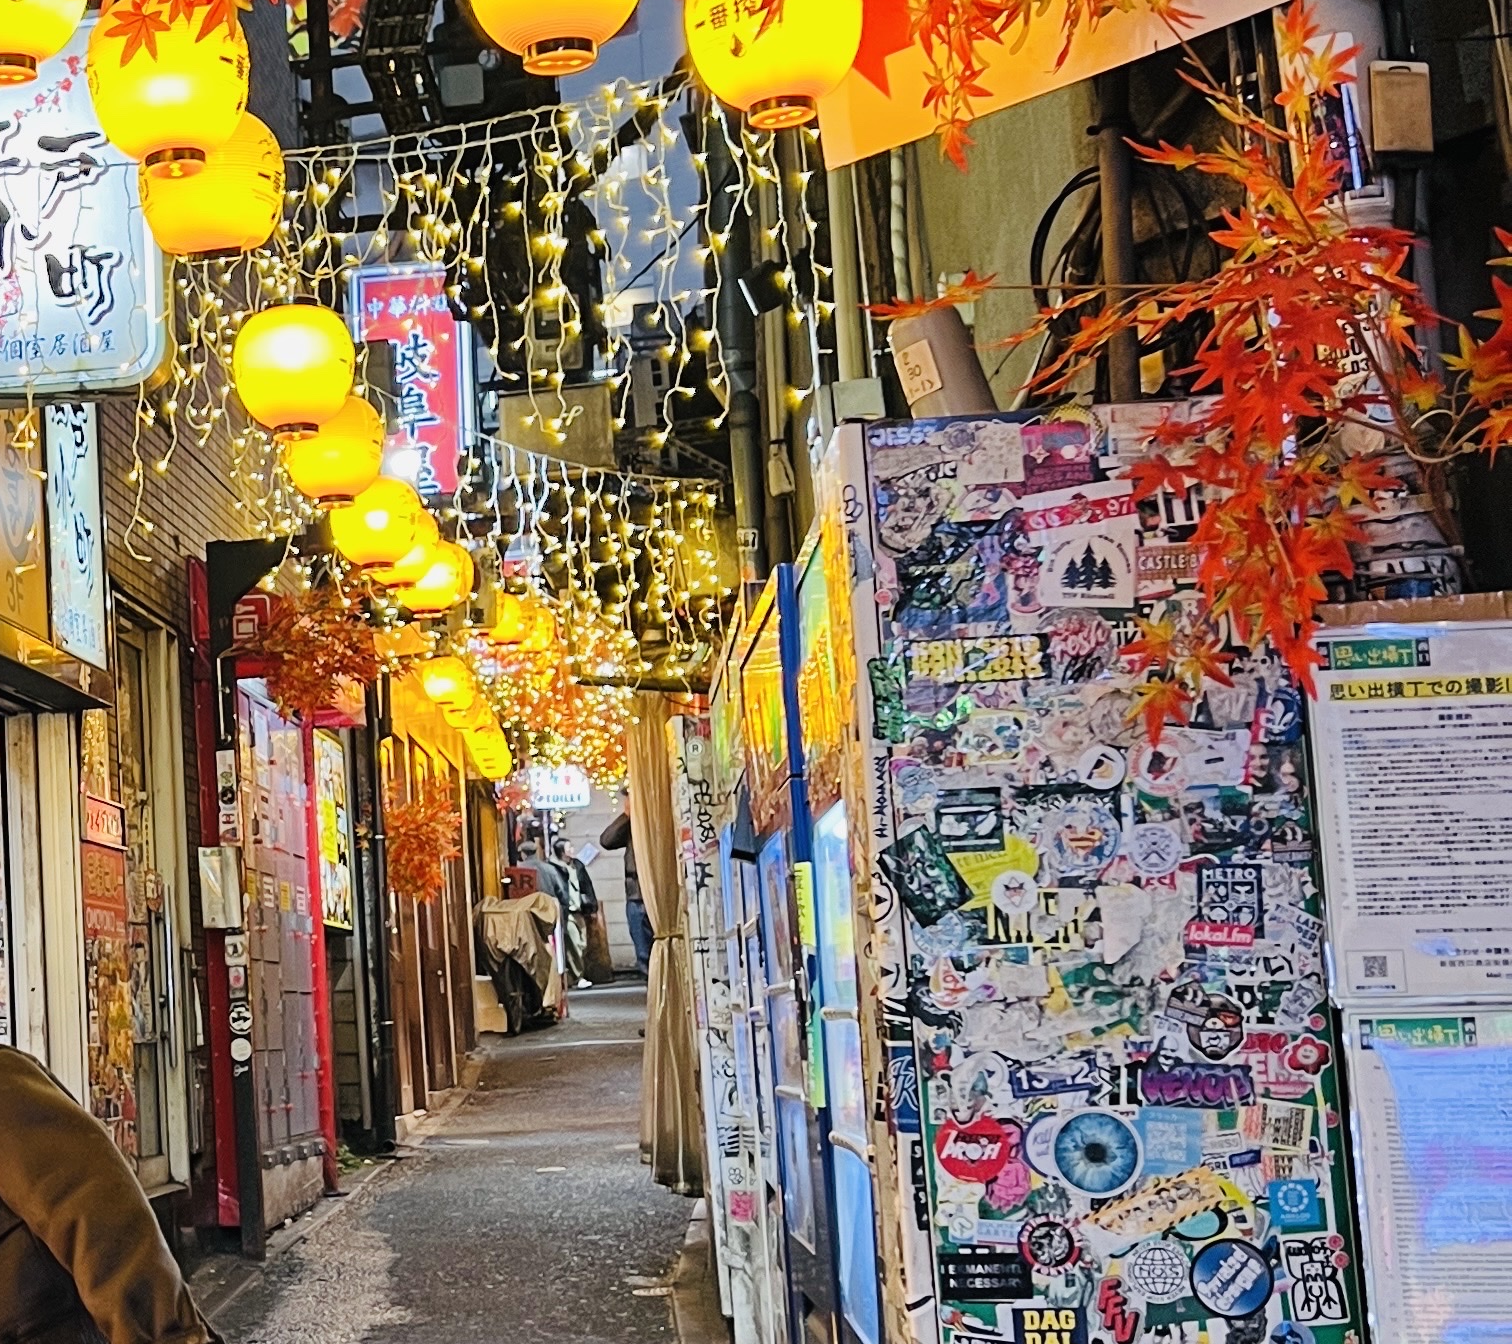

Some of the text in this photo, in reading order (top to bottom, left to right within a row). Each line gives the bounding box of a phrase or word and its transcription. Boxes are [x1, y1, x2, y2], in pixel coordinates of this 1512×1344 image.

[1139, 554, 1185, 571] CASTLE
[1202, 867, 1257, 881] METRO
[1188, 924, 1254, 945] lokal.fm
[1023, 1310, 1077, 1331] DAG
